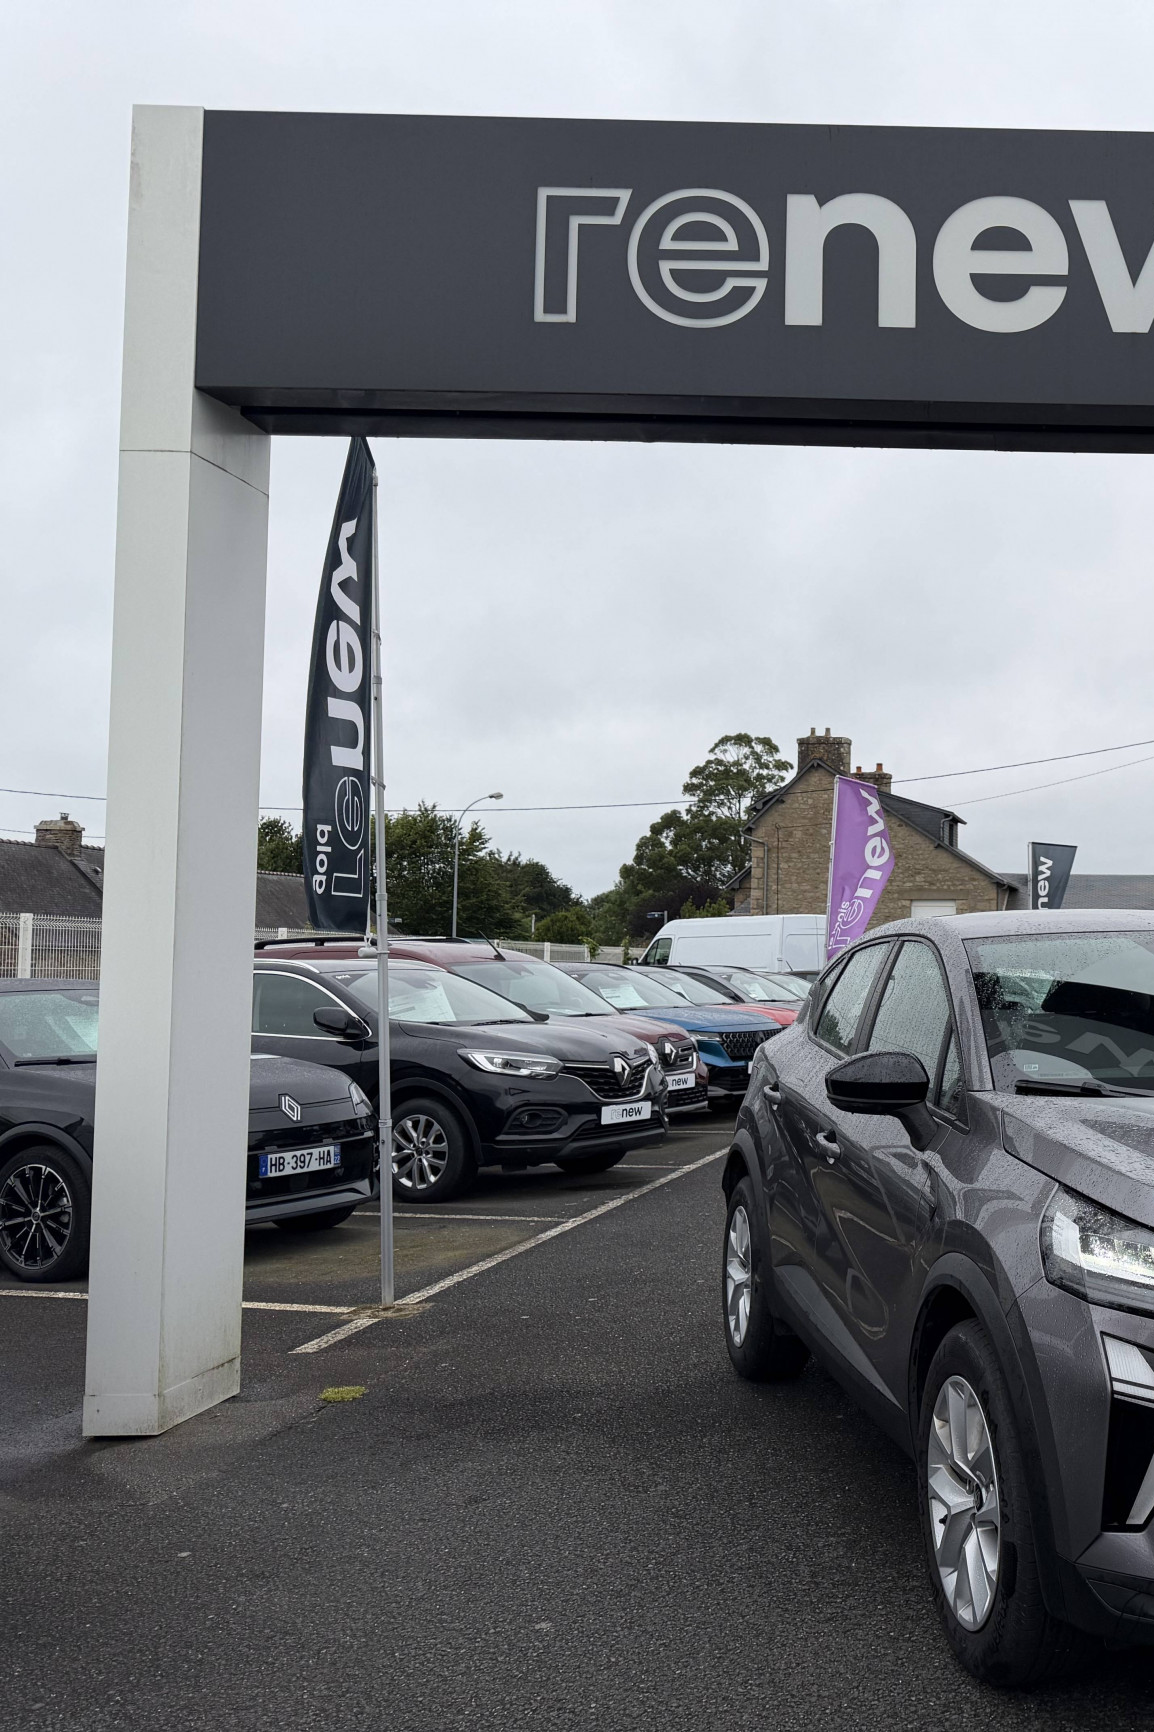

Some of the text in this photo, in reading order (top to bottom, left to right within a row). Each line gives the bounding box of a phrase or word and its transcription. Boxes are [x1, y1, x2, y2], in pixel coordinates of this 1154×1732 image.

[832, 788, 890, 949] renew
[610, 1105, 643, 1121] renew
[269, 1149, 332, 1174] HB-397-HA
